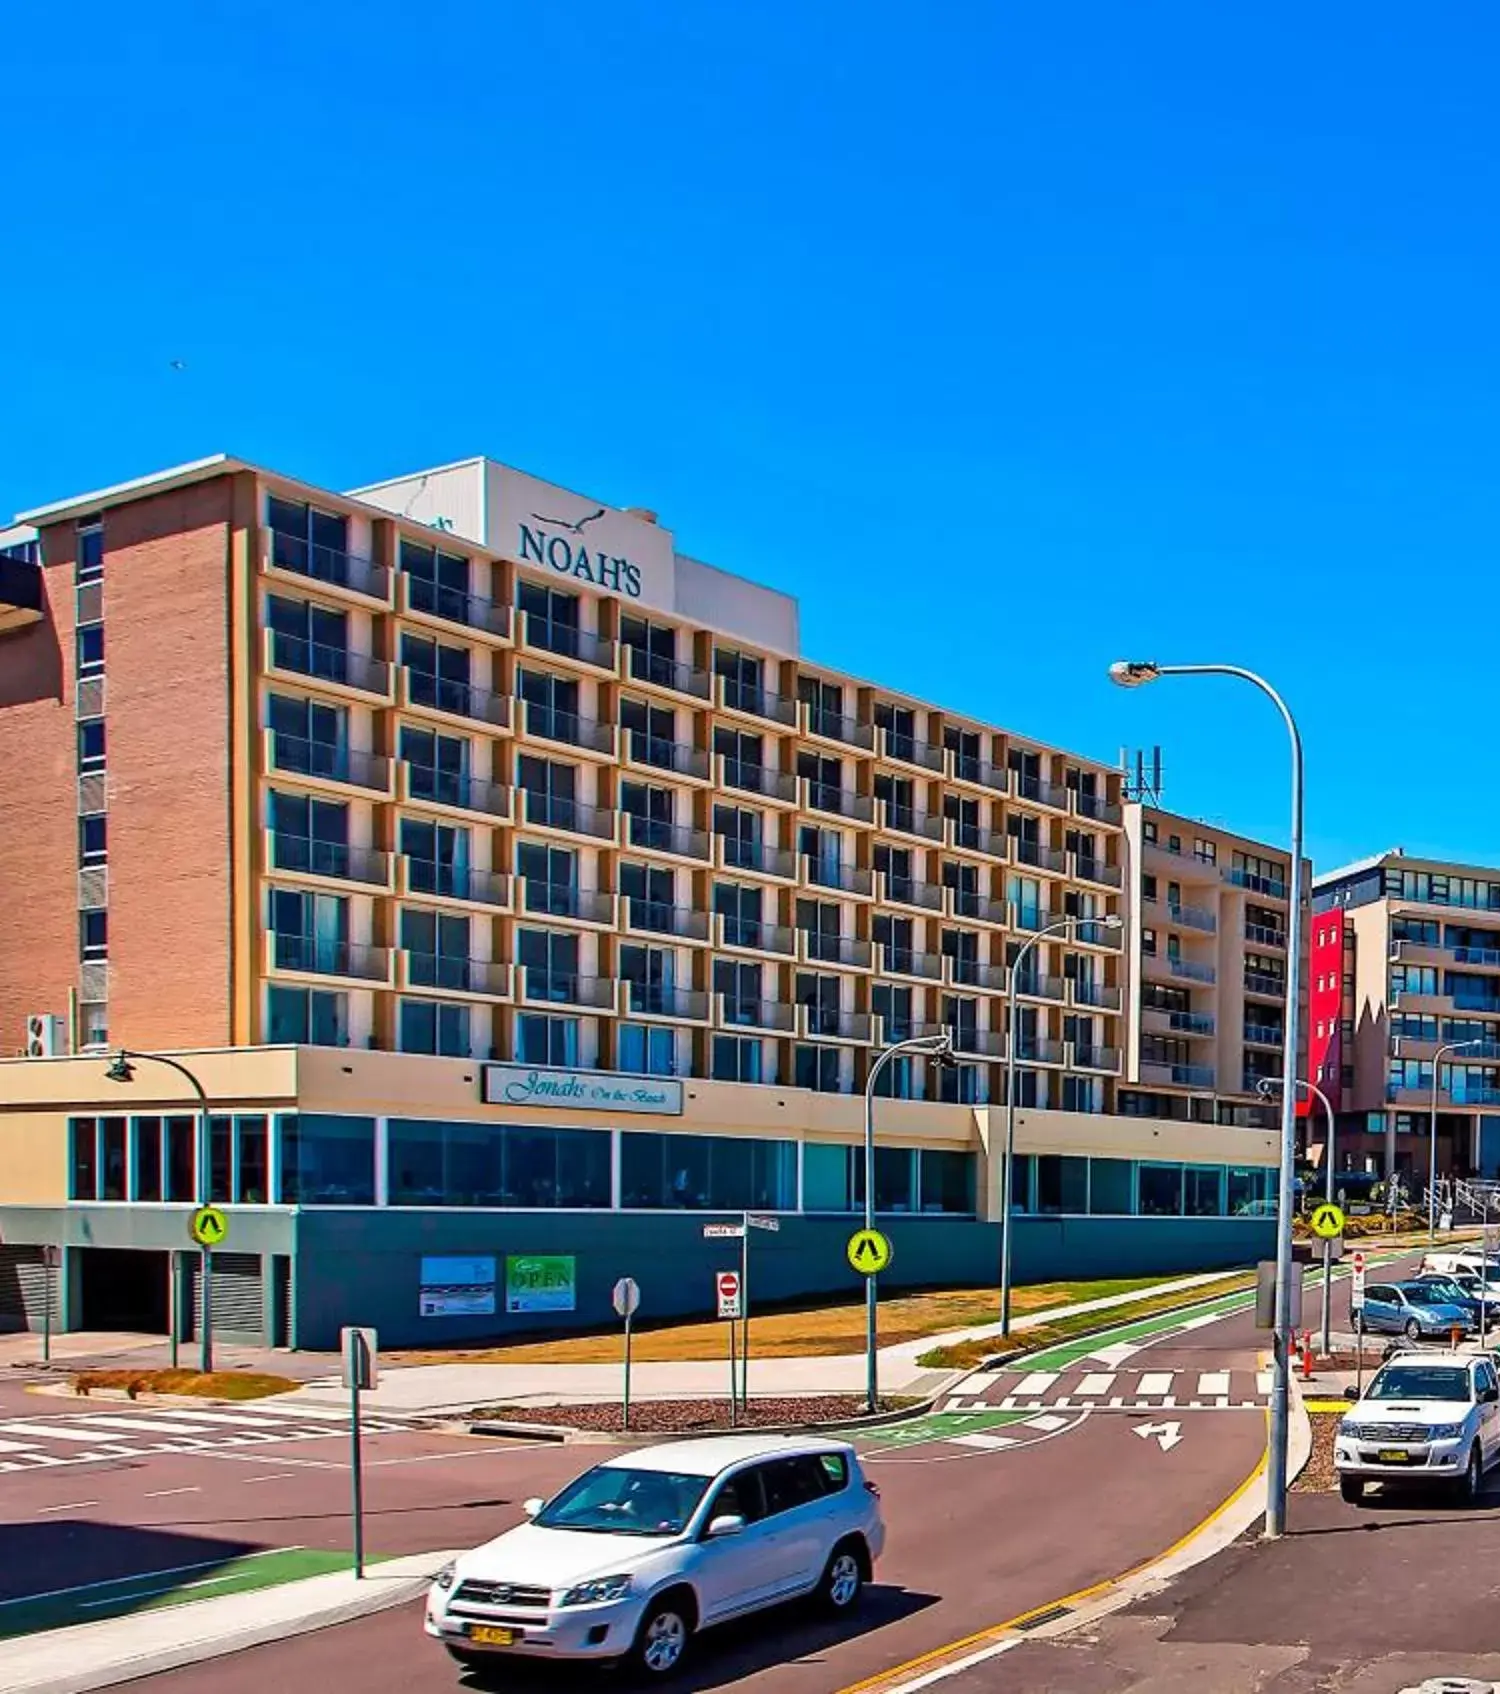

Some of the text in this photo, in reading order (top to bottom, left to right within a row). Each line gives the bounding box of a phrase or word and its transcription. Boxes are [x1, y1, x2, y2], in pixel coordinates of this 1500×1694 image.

[518, 523, 642, 597] NOAH'S
[505, 1071, 586, 1102] Jonahs
[512, 1271, 570, 1289] OPEN
